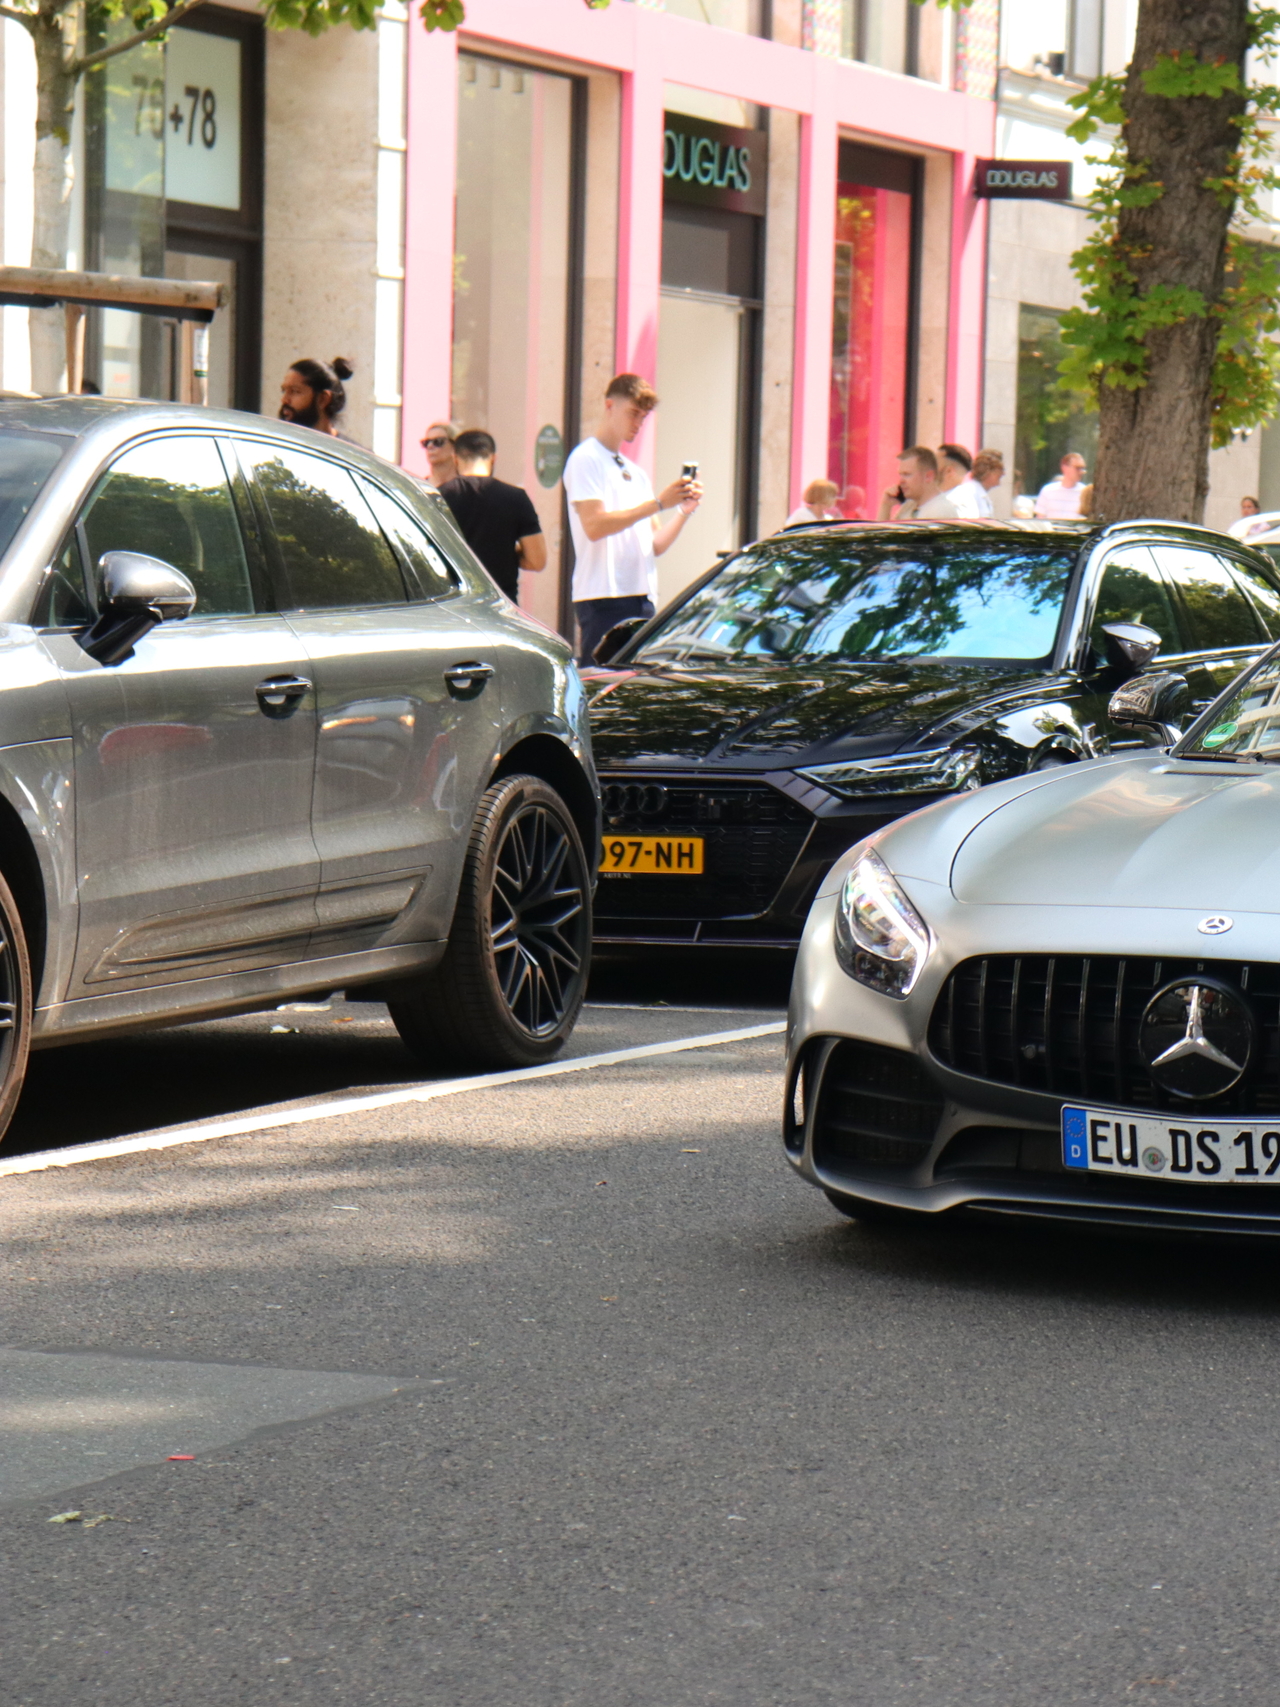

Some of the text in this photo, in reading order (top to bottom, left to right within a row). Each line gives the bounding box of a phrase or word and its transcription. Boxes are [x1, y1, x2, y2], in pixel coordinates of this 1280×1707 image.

[663, 129, 751, 193] OUGLAS
[986, 169, 1058, 188] DOUGLAS
[1071, 1146, 1081, 1158] D
[1090, 1119, 1139, 1168] EU
[1168, 1128, 1221, 1175] DS
